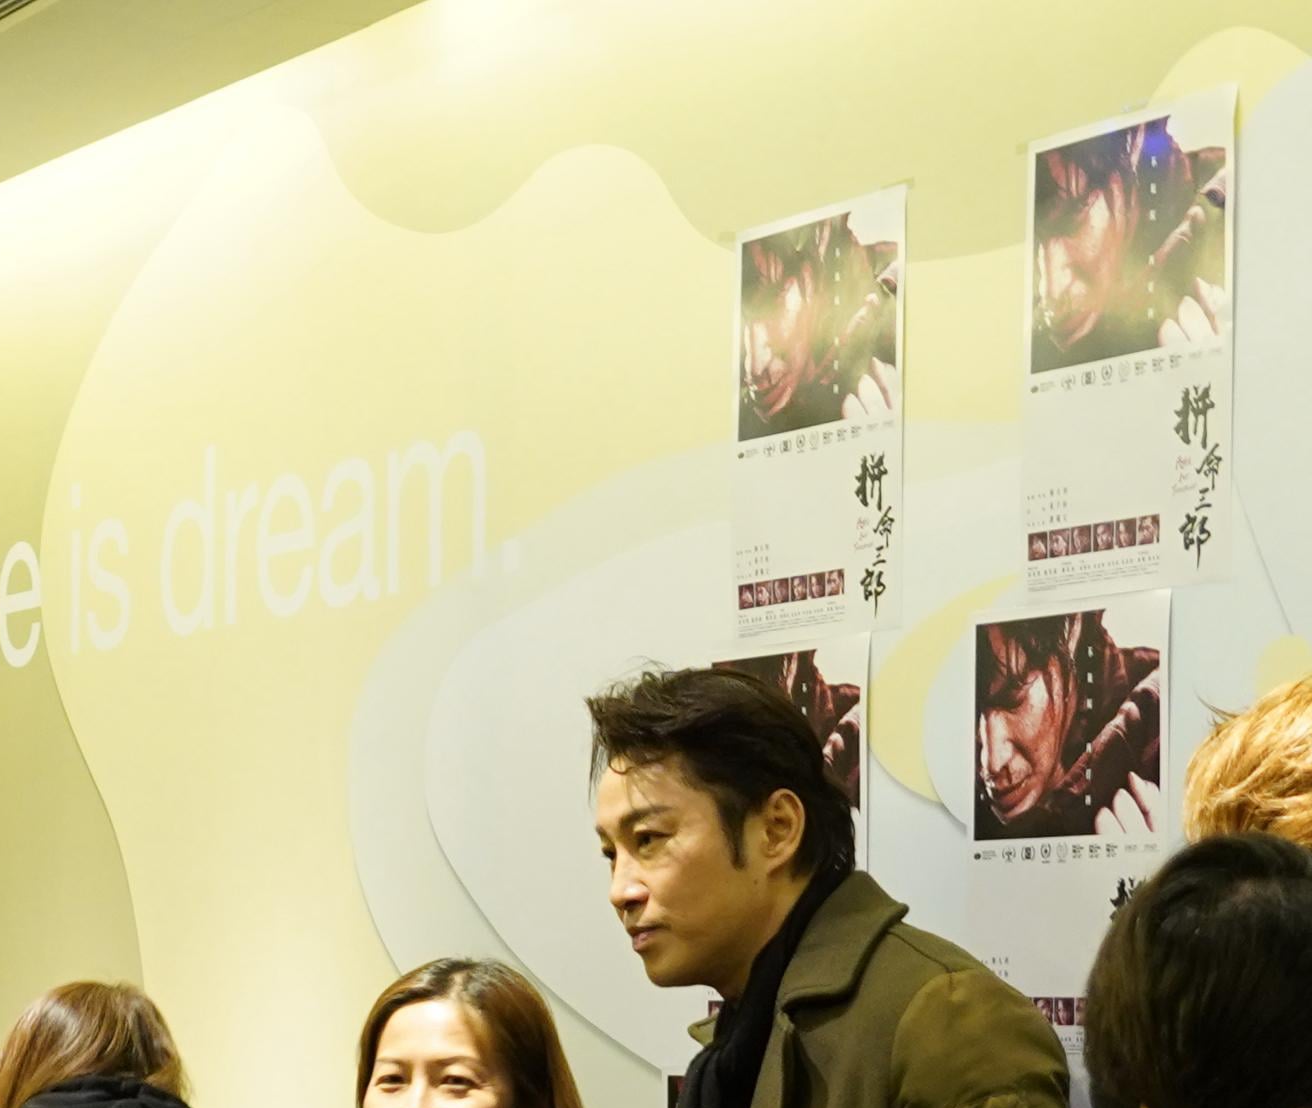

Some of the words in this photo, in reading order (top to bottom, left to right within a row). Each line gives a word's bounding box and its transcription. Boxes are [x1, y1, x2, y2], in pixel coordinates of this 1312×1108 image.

[70, 483, 131, 655] is
[160, 430, 519, 637] dream.
[855, 452, 895, 619] 拼命三郎
[1174, 384, 1223, 569] 拼命三郎
